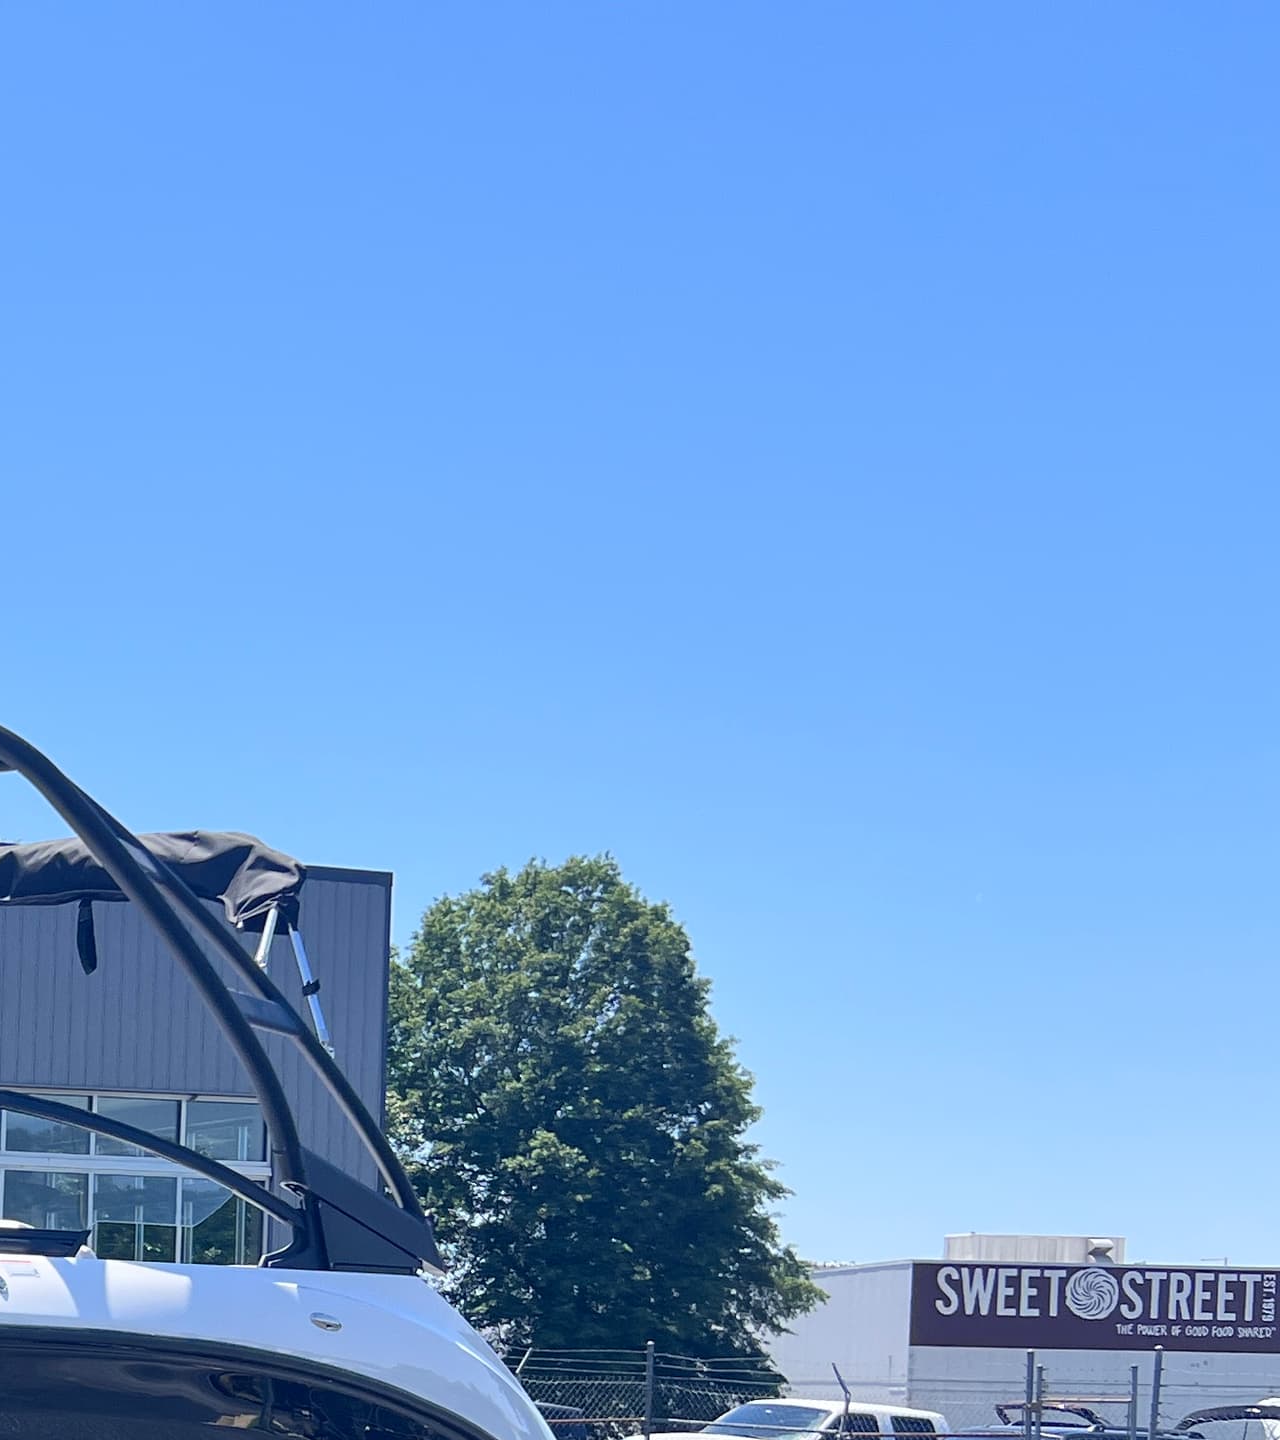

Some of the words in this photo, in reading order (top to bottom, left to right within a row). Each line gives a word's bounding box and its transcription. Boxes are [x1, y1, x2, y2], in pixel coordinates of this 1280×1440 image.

[935, 1266, 1067, 1317] SWEET
[1120, 1270, 1262, 1322] STREET
[1262, 1274, 1276, 1297] EST.
[1115, 1323, 1134, 1335] THE
[1137, 1324, 1168, 1336] POWER
[1171, 1325, 1182, 1336] OF
[1185, 1325, 1209, 1337] GOOD
[1211, 1325, 1234, 1337] FOOD
